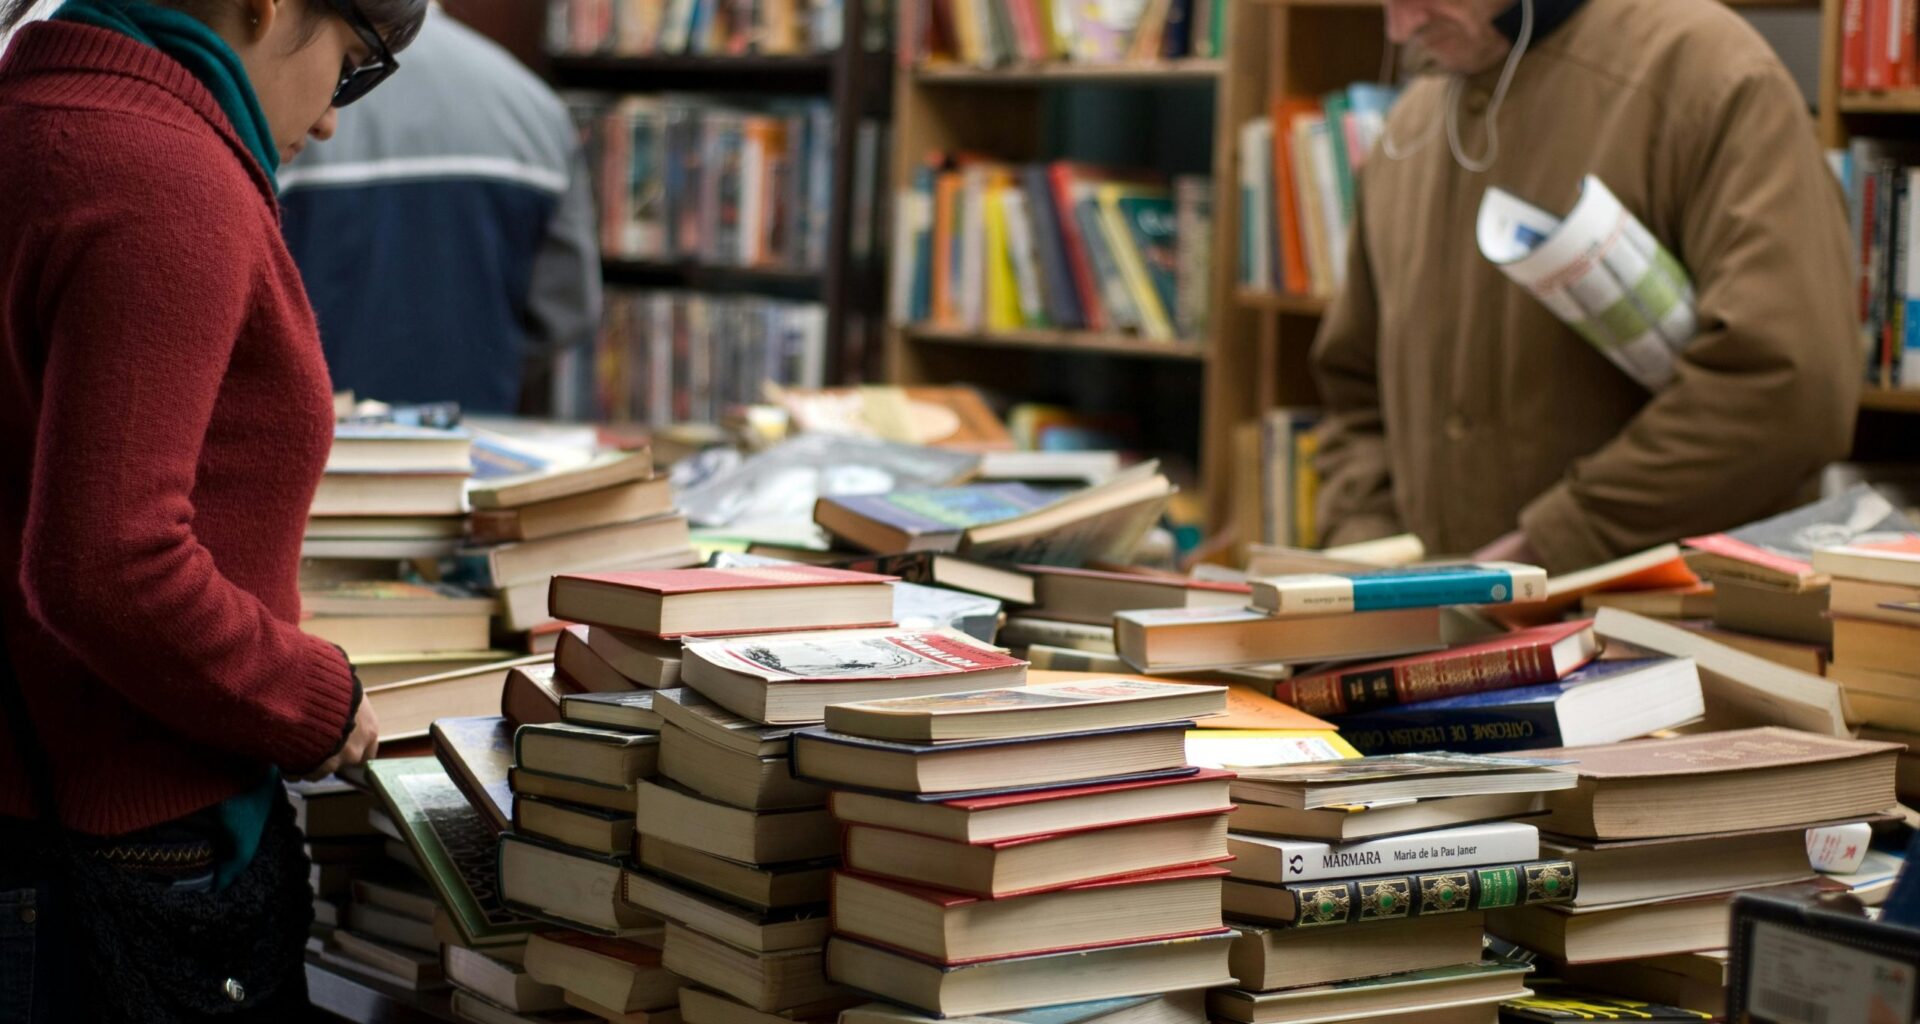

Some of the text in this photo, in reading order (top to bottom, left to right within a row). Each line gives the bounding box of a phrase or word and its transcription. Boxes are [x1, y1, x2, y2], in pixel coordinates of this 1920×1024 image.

[1449, 724, 1468, 743] DE
[1472, 720, 1534, 741] CATECISME
[1393, 849, 1417, 861] Maria
[1418, 848, 1429, 859] de
[1430, 846, 1439, 858] la
[1440, 846, 1455, 857] Pau
[1457, 845, 1477, 857] Janer
